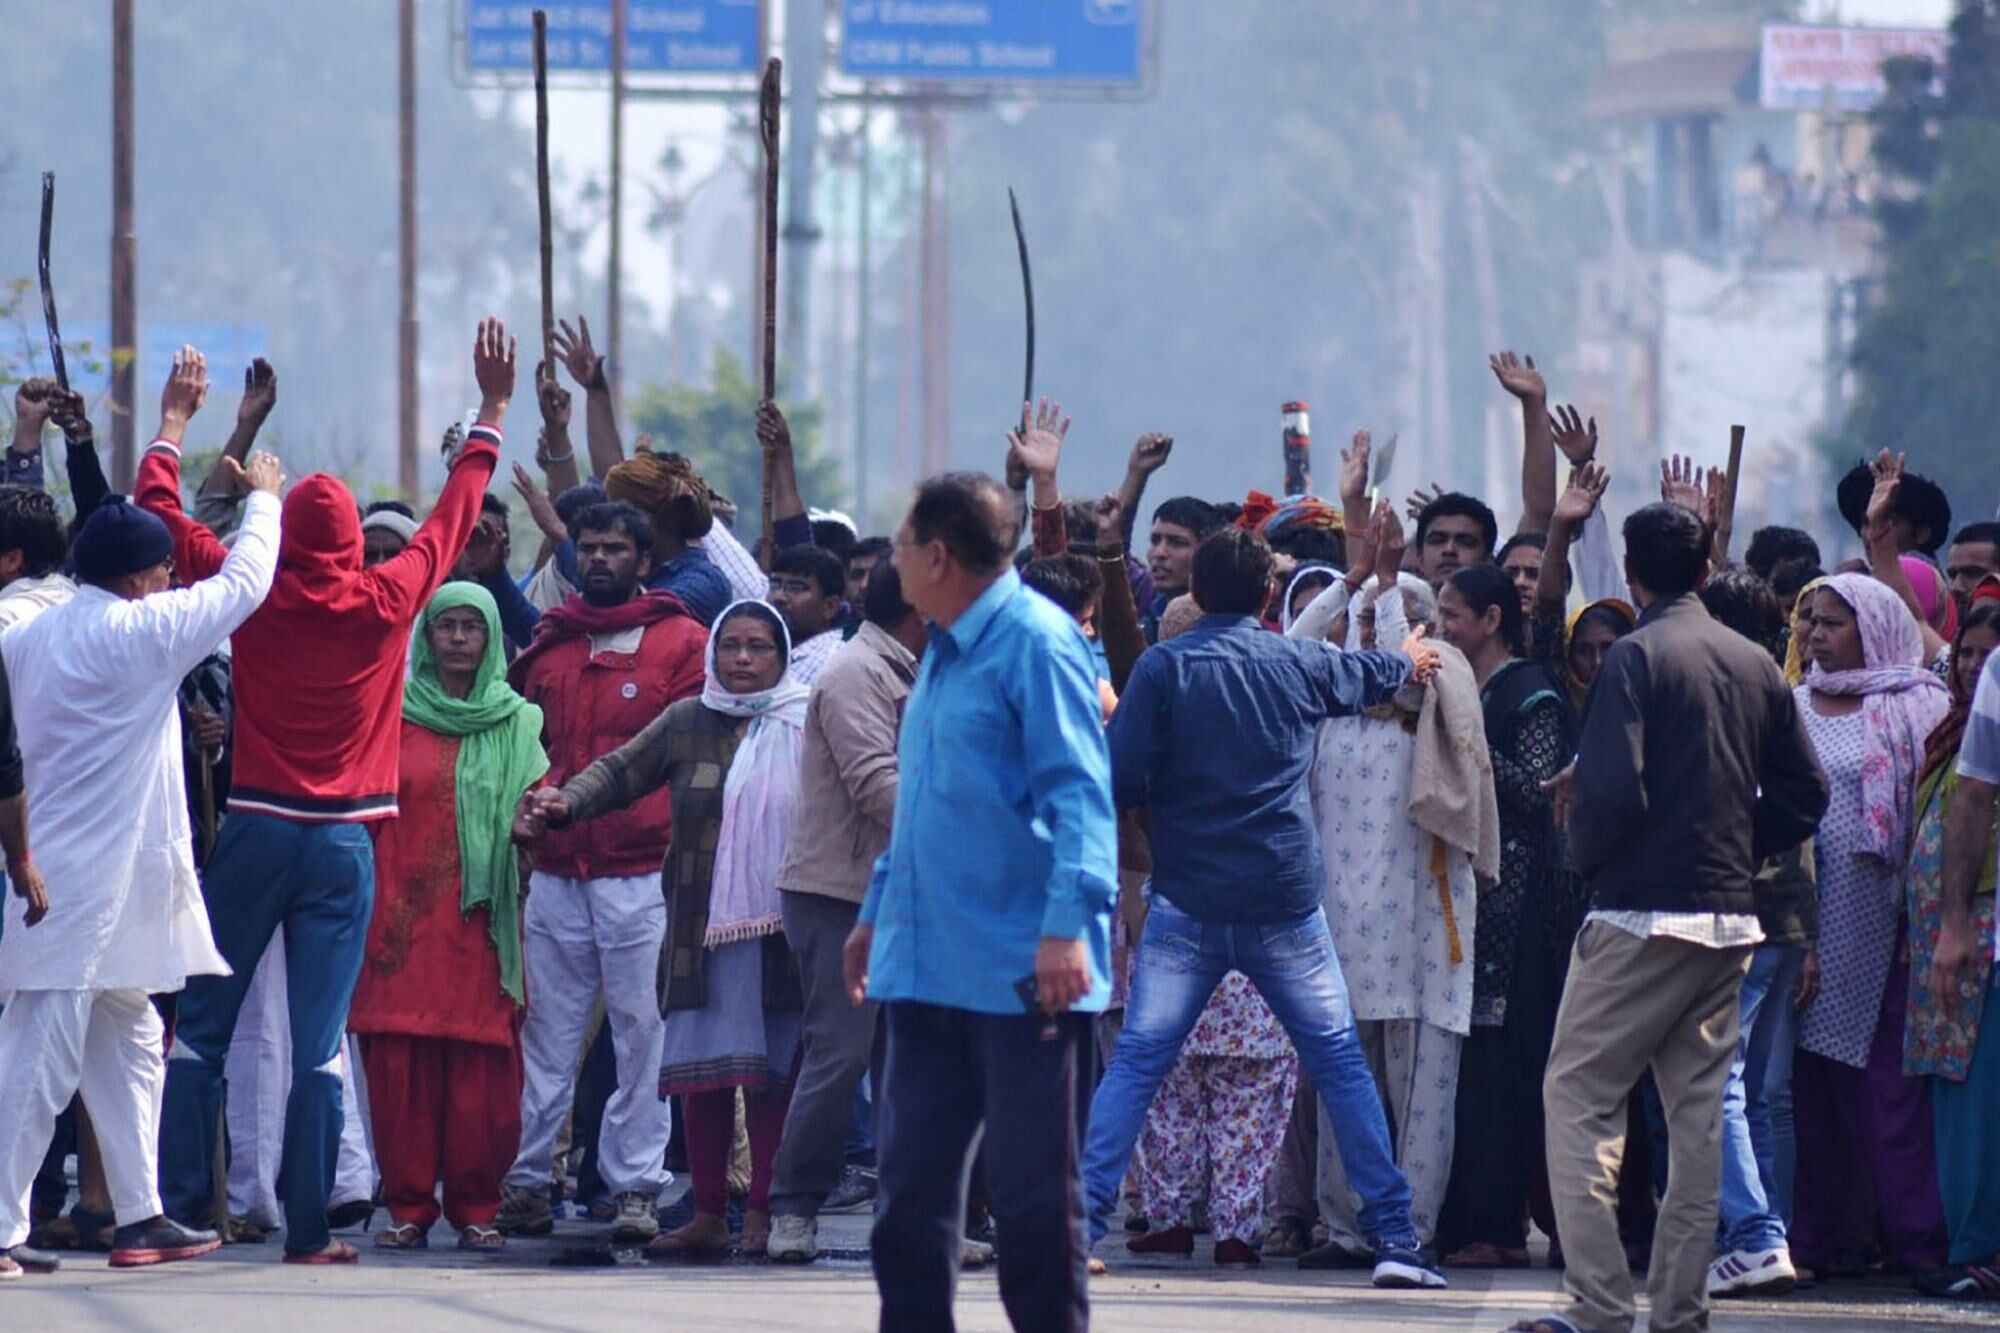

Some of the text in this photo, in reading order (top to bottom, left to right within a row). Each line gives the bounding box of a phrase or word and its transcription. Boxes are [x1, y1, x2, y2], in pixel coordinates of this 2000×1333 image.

[632, 9, 703, 31] School
[850, 2, 988, 24] of Education
[667, 42, 740, 66] School
[906, 41, 971, 65] Public
[978, 42, 1054, 66] School
